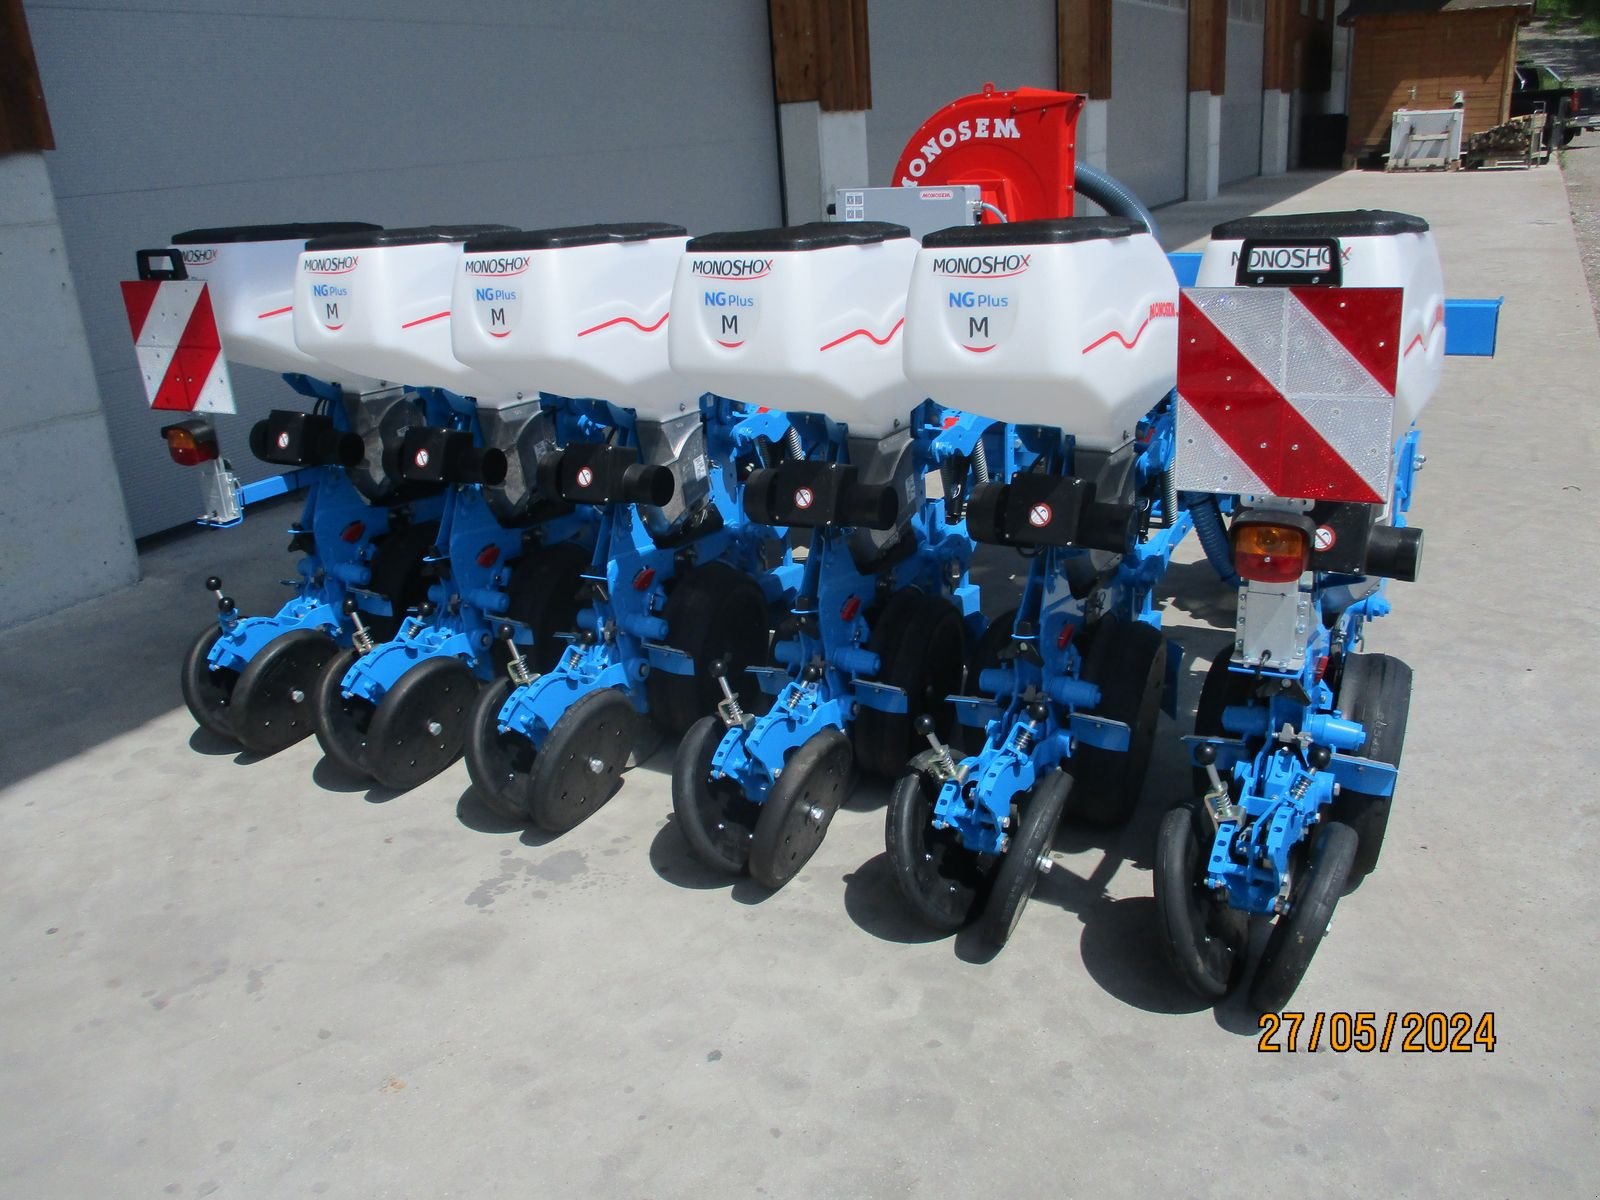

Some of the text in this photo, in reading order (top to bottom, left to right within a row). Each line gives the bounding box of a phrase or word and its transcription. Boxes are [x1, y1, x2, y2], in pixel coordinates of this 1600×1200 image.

[304, 256, 359, 271] MONOSHOX
[465, 256, 531, 273] MONOSHOX
[692, 259, 774, 276] MONOSHOX
[933, 254, 1031, 274] MONOSHOX
[313, 284, 348, 297] NG Plus
[476, 287, 517, 301] NG Plus
[704, 291, 754, 307] NG Plus
[949, 291, 1009, 308] NG Plus
[326, 303, 339, 319] M
[491, 307, 506, 326] M
[721, 314, 738, 335] M
[969, 316, 989, 338] M
